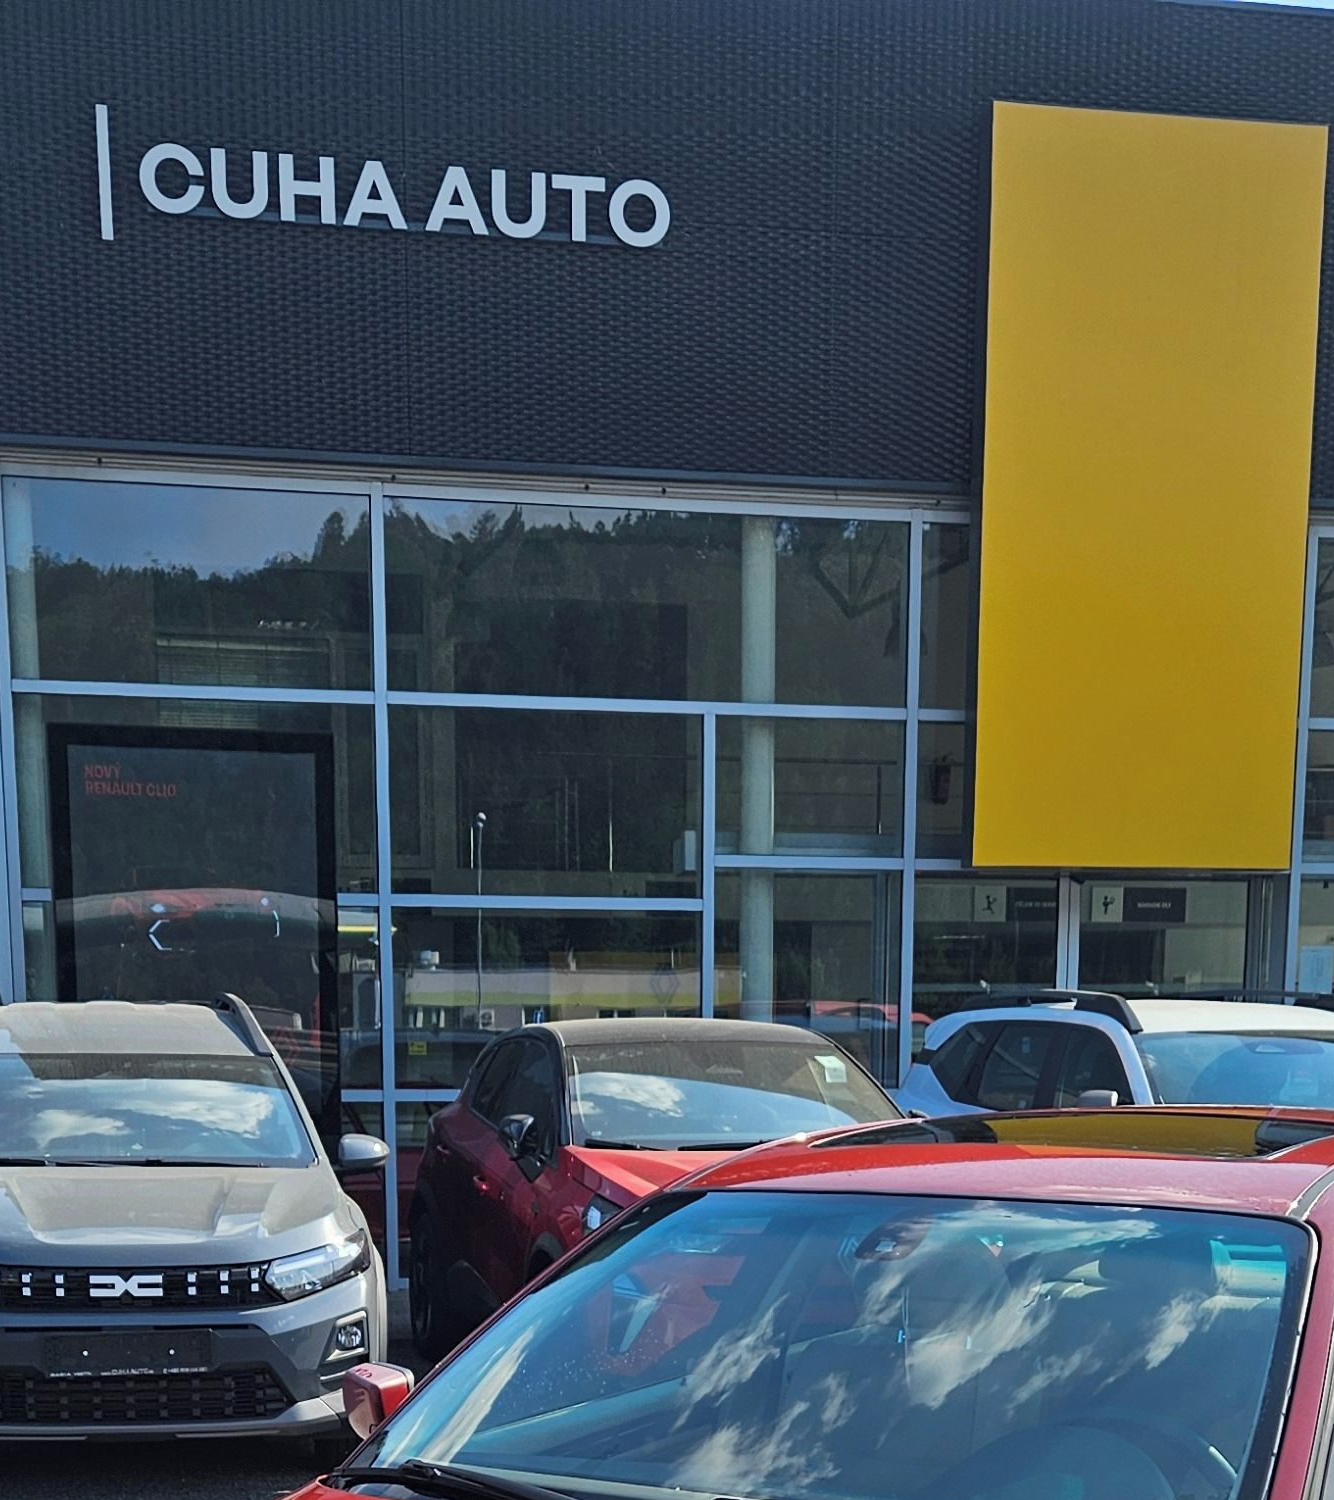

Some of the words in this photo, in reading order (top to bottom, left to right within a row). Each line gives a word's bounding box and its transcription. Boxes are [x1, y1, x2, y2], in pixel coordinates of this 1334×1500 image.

[138, 142, 408, 231] CUHA
[424, 165, 671, 248] AUTO
[85, 781, 143, 796] RENAULT
[146, 783, 177, 797] CLIO
